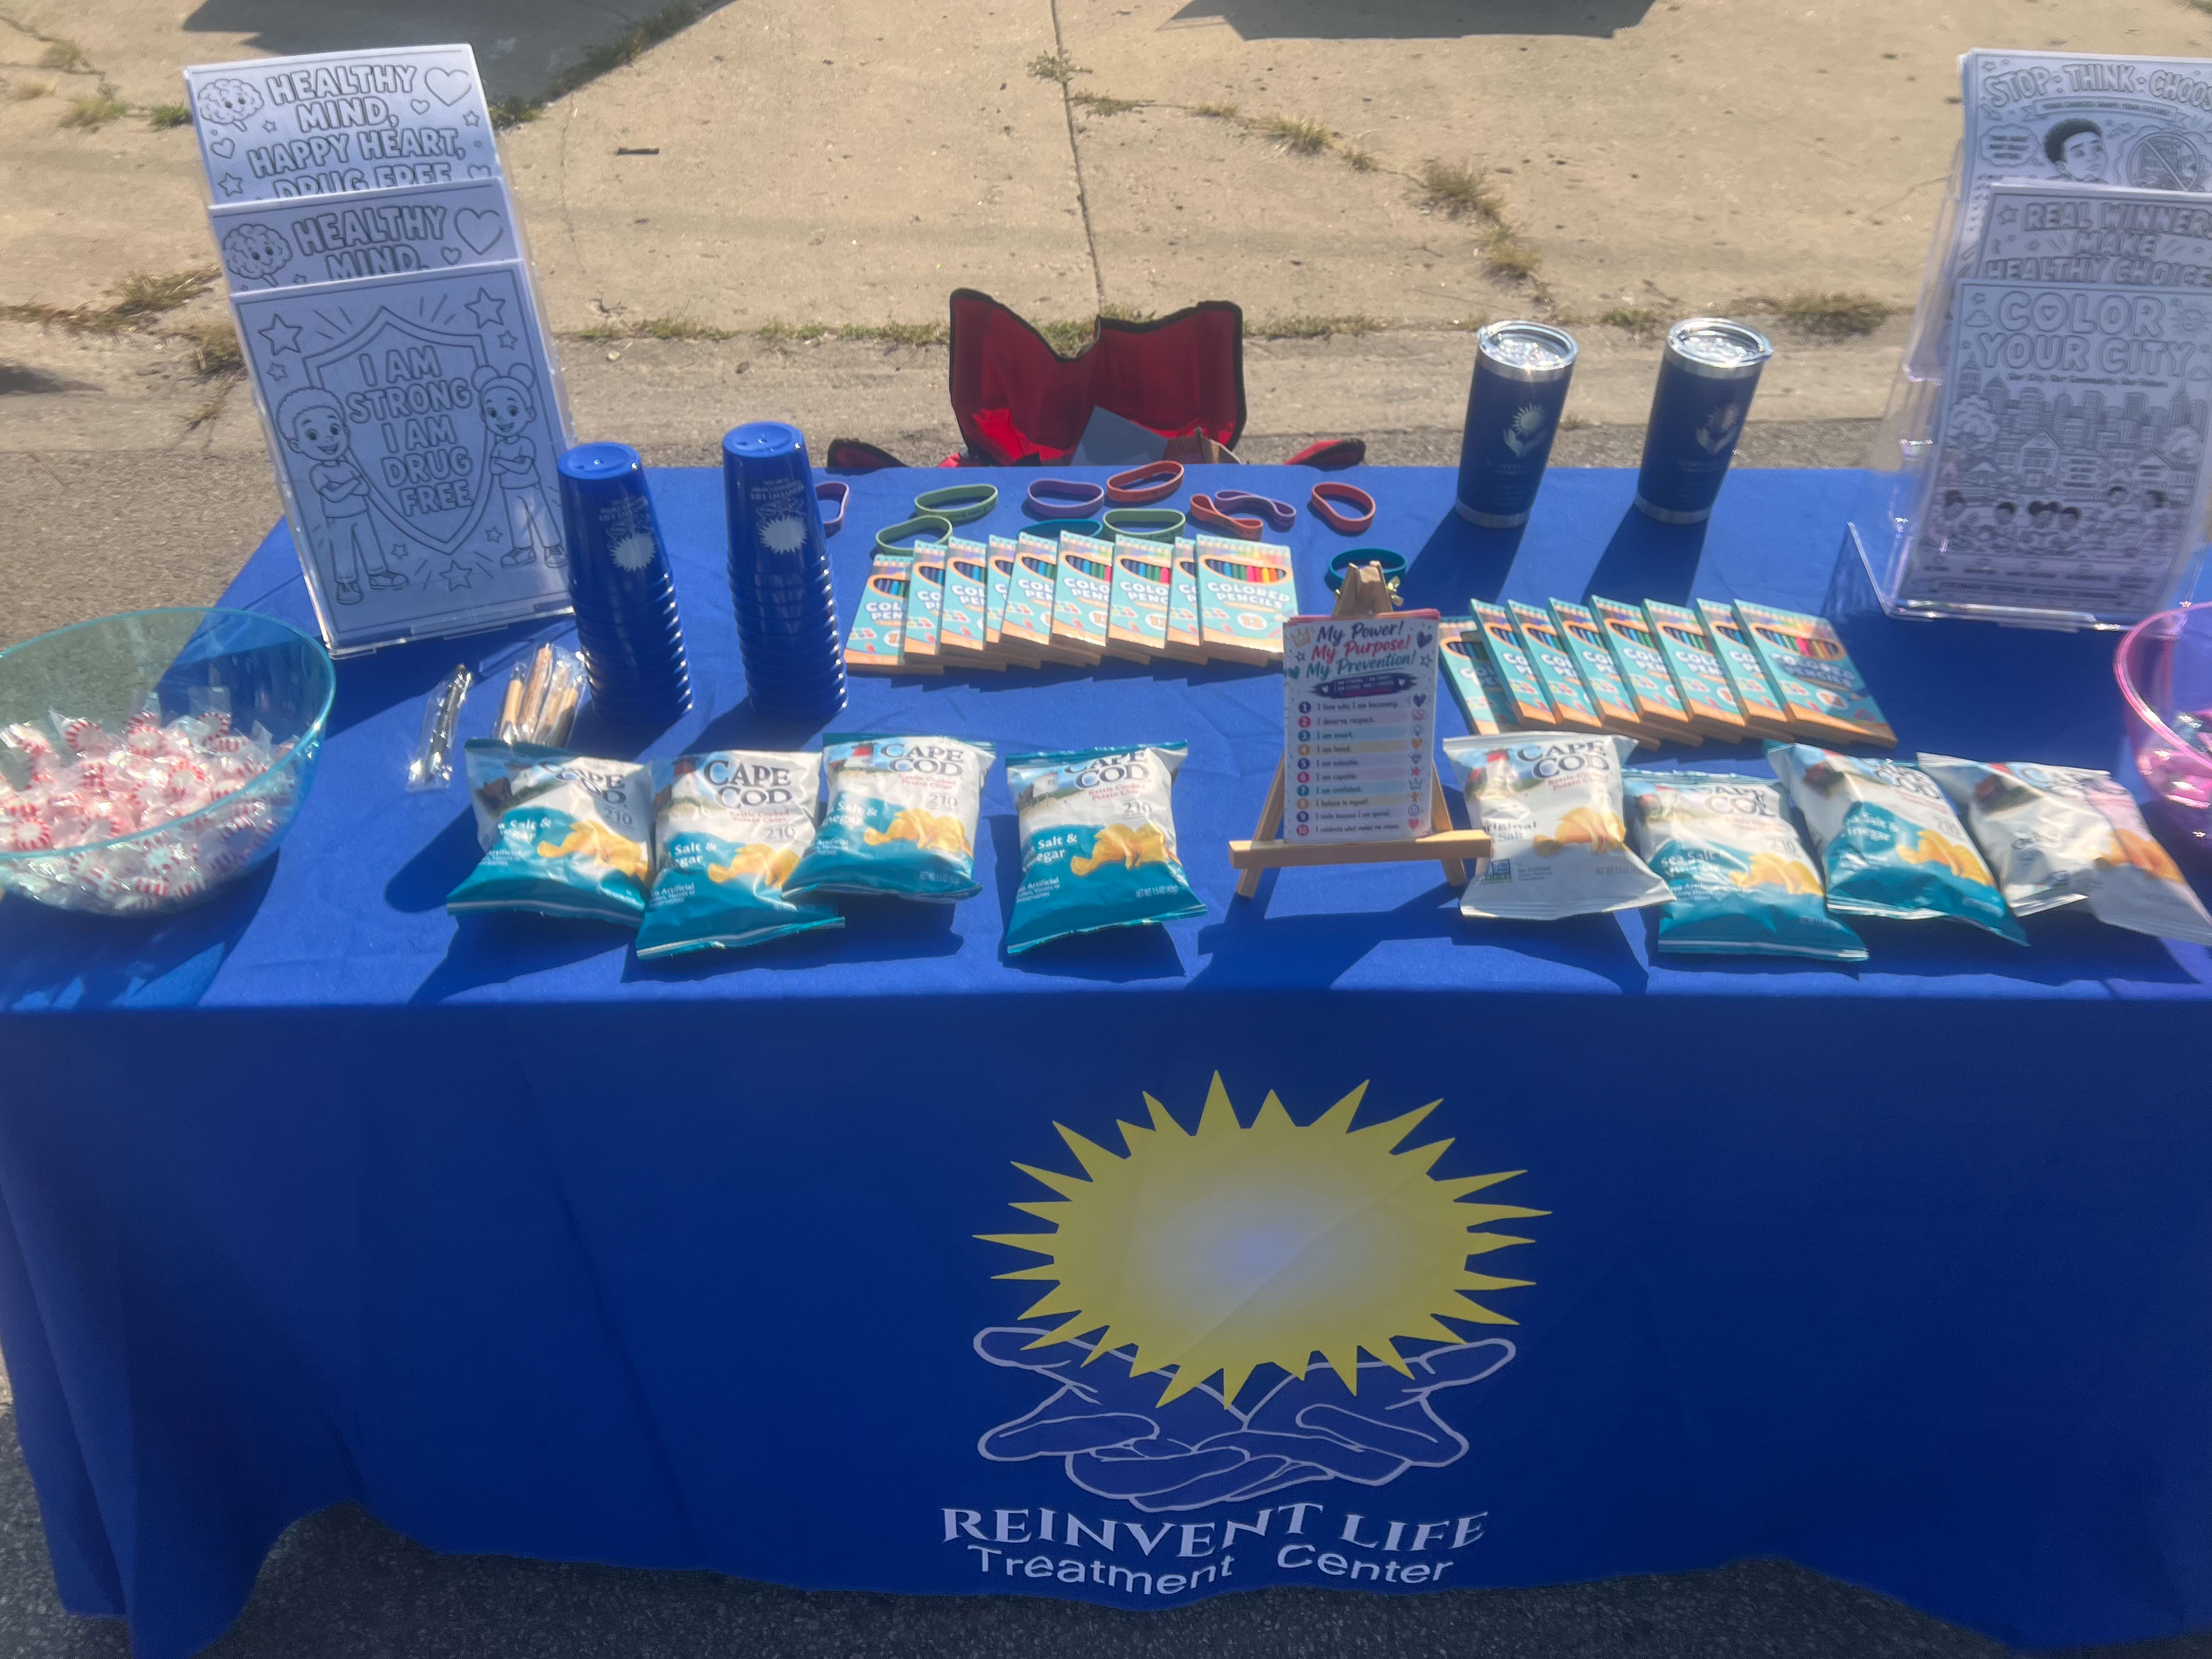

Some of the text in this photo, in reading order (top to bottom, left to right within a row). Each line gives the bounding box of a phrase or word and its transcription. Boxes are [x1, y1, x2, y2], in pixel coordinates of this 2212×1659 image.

[267, 64, 417, 105] HEALTHY
[1984, 63, 2212, 111] STOP THINK CHOOS
[296, 96, 399, 133] MIND,
[247, 127, 466, 179] HAPPY HEART,
[292, 206, 446, 257] HEALTHY
[2024, 202, 2212, 239] REAL WINNER
[2072, 228, 2160, 258] MAKE
[1984, 256, 2212, 285] HEALTHY CHOICE
[1997, 291, 2166, 338] COLOR
[359, 345, 442, 386] I AM
[1978, 332, 2194, 377] YOUR CITY
[345, 377, 473, 424] STRONG
[380, 415, 458, 454] I AM
[380, 446, 473, 488] DRUG
[398, 479, 474, 517] FREE
[1064, 578, 1110, 592] COLO
[1071, 588, 1109, 601] PENC
[1120, 581, 1168, 596] COLO
[1207, 582, 1290, 601] COLORED
[1127, 592, 1168, 604] PENC
[1216, 592, 1283, 610] PENCILS
[1317, 620, 1404, 646] My Power!
[1311, 635, 1411, 664] My Purpose!
[1306, 650, 1416, 680] My Prevention!
[1323, 702, 1335, 710] love
[1323, 716, 1347, 725] deserve
[880, 743, 964, 764] CAPE
[1516, 742, 1606, 761] CAPE
[704, 759, 792, 787] CAPE
[888, 758, 963, 776] COD
[1075, 764, 1149, 788] COD
[1533, 755, 1610, 778] COD
[715, 786, 794, 809] COD
[929, 793, 958, 806] 210
[604, 807, 633, 825] 210
[867, 808, 878, 816] &
[764, 826, 795, 840] 210
[1483, 821, 1537, 832] riginal
[1498, 831, 1523, 842] Salt
[674, 842, 717, 855] Salt &
[1037, 833, 1077, 850] Salt &
[1027, 877, 1059, 889] Artificial
[941, 1503, 1489, 1558] REINVENT LIFE
[967, 1543, 1454, 1595] Treatment Center
